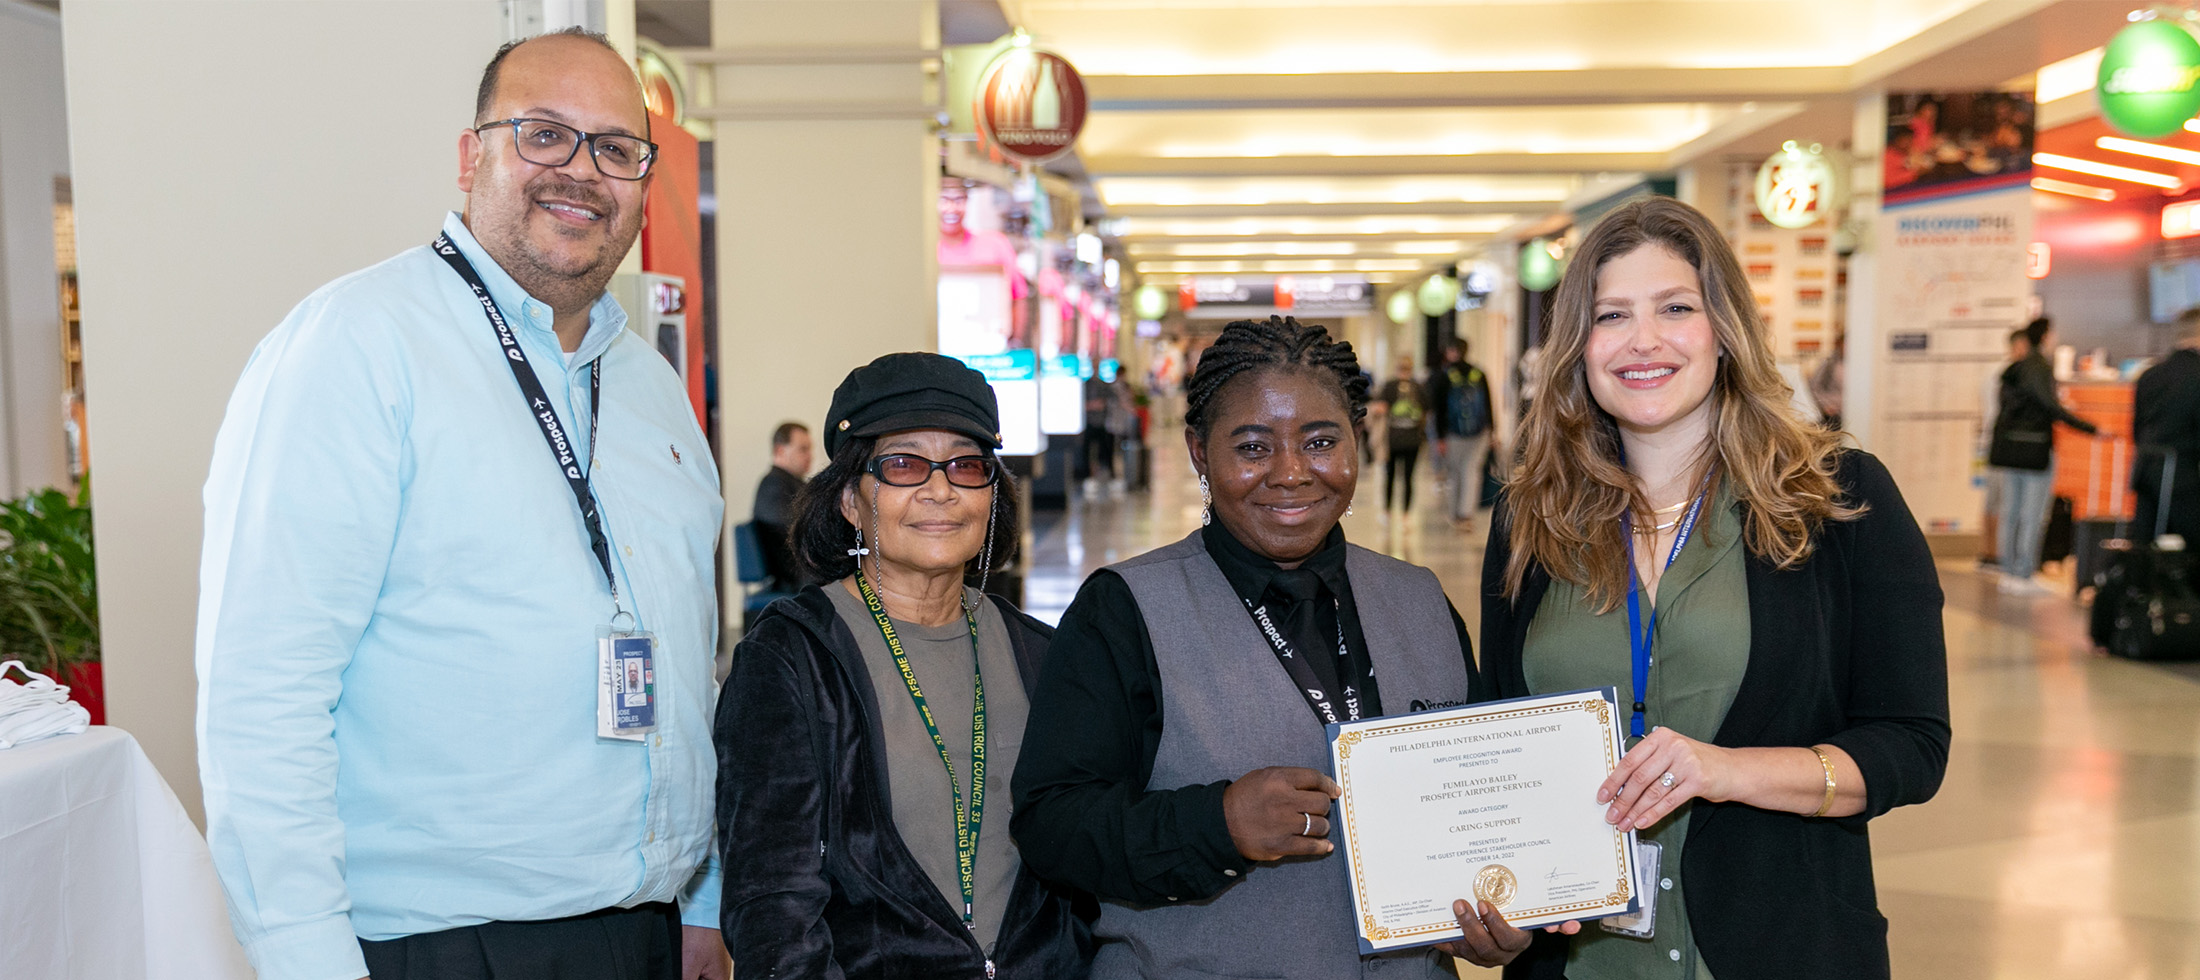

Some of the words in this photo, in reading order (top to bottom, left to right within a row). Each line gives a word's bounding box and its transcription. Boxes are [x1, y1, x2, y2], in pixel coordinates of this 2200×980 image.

[480, 296, 515, 346] Prospect
[540, 411, 573, 466] Prospect
[858, 577, 882, 612] COUNCIL
[875, 614, 904, 655] DISTRICT
[1254, 605, 1287, 650] Prospect
[897, 656, 923, 698] AFSCME
[616, 709, 630, 717] JOSE
[934, 734, 944, 746] 33
[973, 713, 985, 760] DISTRICT
[1389, 740, 1452, 753] PHILADELPHIA
[1453, 730, 1523, 745] INTERNATIONAL
[1525, 724, 1562, 735] AIRPORT
[1433, 755, 1461, 764] EMPLOYEE
[1462, 750, 1500, 760] RECOGNITION
[1501, 747, 1522, 755] AWARD
[1459, 759, 1489, 768] PRESENTED
[972, 761, 984, 807] COUNCIL
[1420, 791, 1462, 802] PROSPECT
[1464, 786, 1501, 797] AIRPORT
[1503, 780, 1543, 791] SERVICES
[1443, 778, 1487, 789] FUMILAYO
[1488, 774, 1518, 784] BAILEY
[971, 810, 981, 824] 33
[1458, 807, 1479, 815] AWARD
[1480, 804, 1508, 812] CATEGORY
[955, 797, 969, 848] DISTRICT
[1449, 823, 1482, 833] CARING
[1484, 817, 1522, 829] SUPPORT
[1438, 851, 1455, 860] GUEST
[1456, 847, 1488, 857] EXPERIENCE
[1489, 842, 1527, 853] STAKEHOLDER
[1527, 839, 1551, 847] COUNCIL
[1468, 838, 1499, 847] PRESENTED
[1466, 855, 1491, 864] OCTOBER
[959, 849, 974, 897] AFSCME
